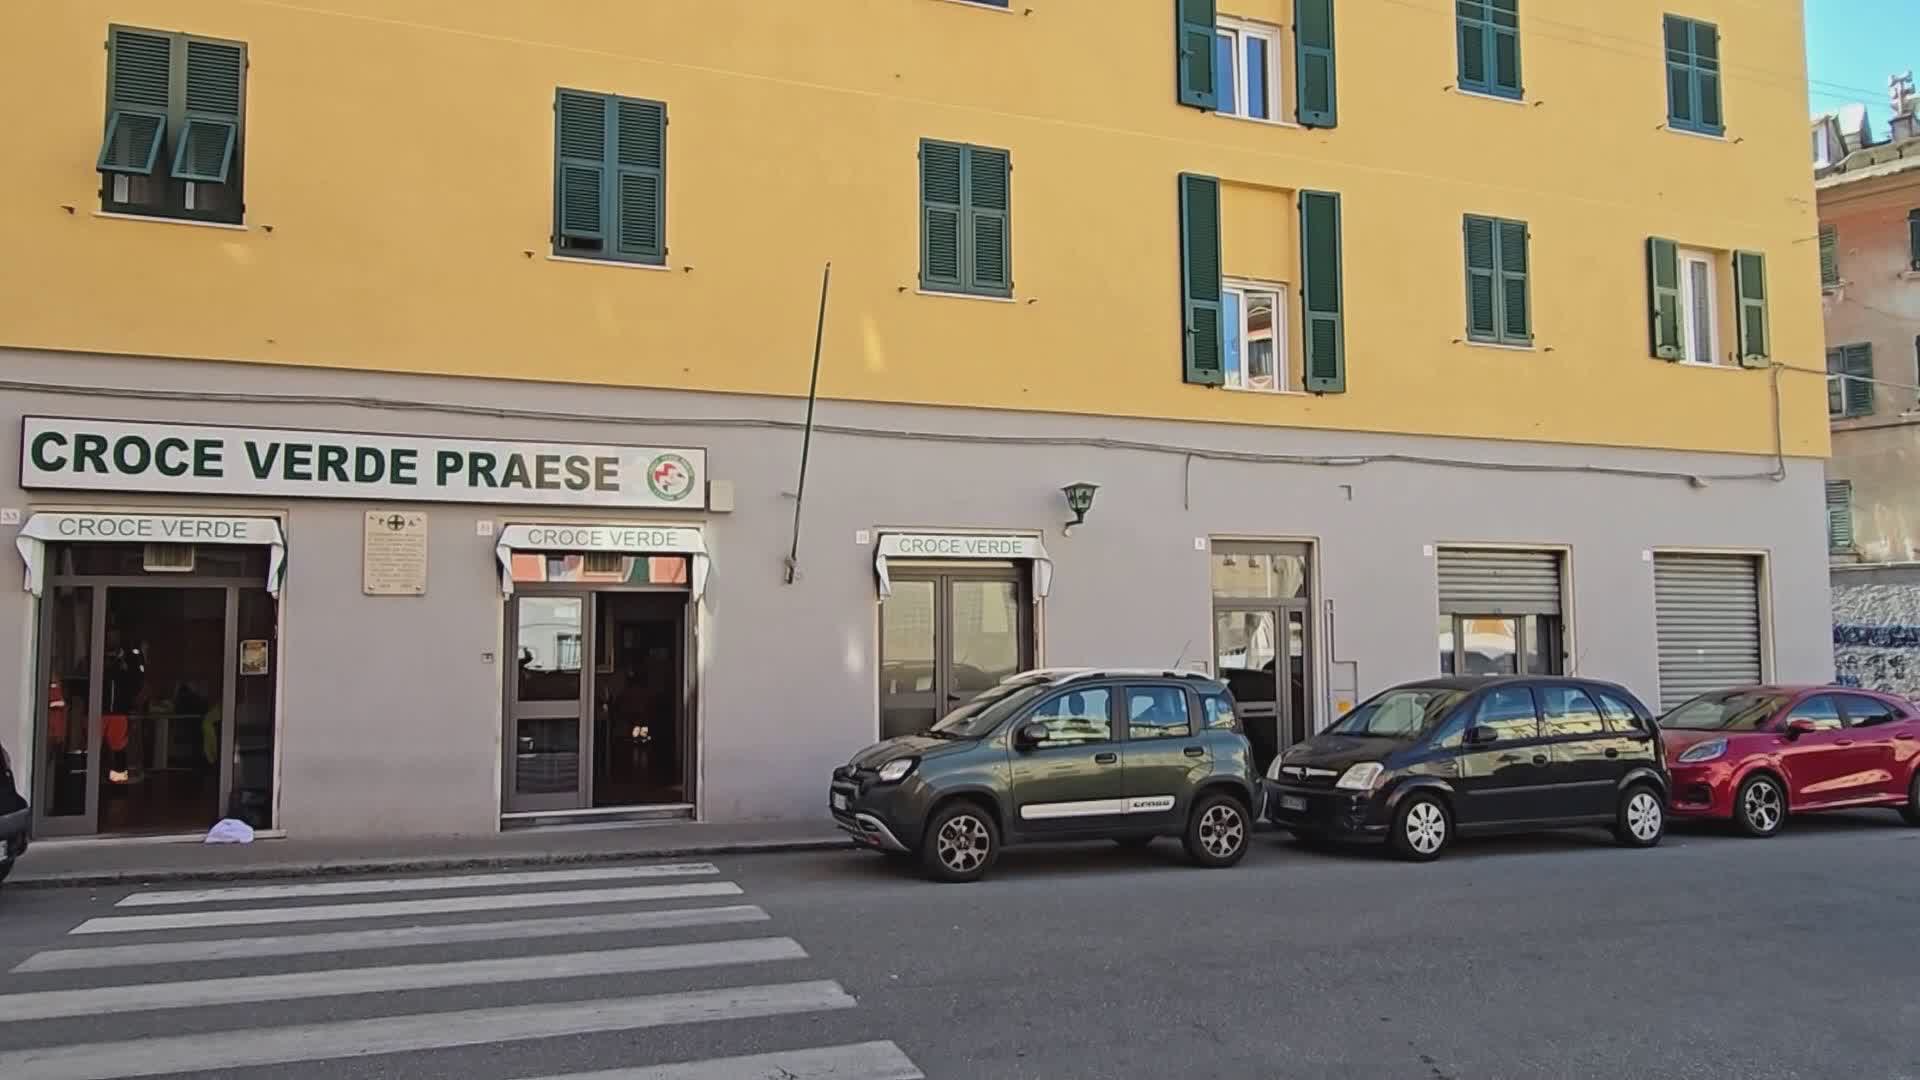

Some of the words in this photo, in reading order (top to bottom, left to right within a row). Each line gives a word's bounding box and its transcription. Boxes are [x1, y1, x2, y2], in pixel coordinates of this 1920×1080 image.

[31, 431, 224, 478] CROCE
[244, 441, 418, 485] VERDE
[436, 450, 620, 491] PRAESE
[58, 518, 152, 536] CROCE
[161, 520, 247, 538] VERDE
[528, 529, 602, 546] CROCE
[610, 531, 678, 547] VERDE
[899, 538, 960, 553] CROCE
[965, 540, 1023, 554] VERDE
